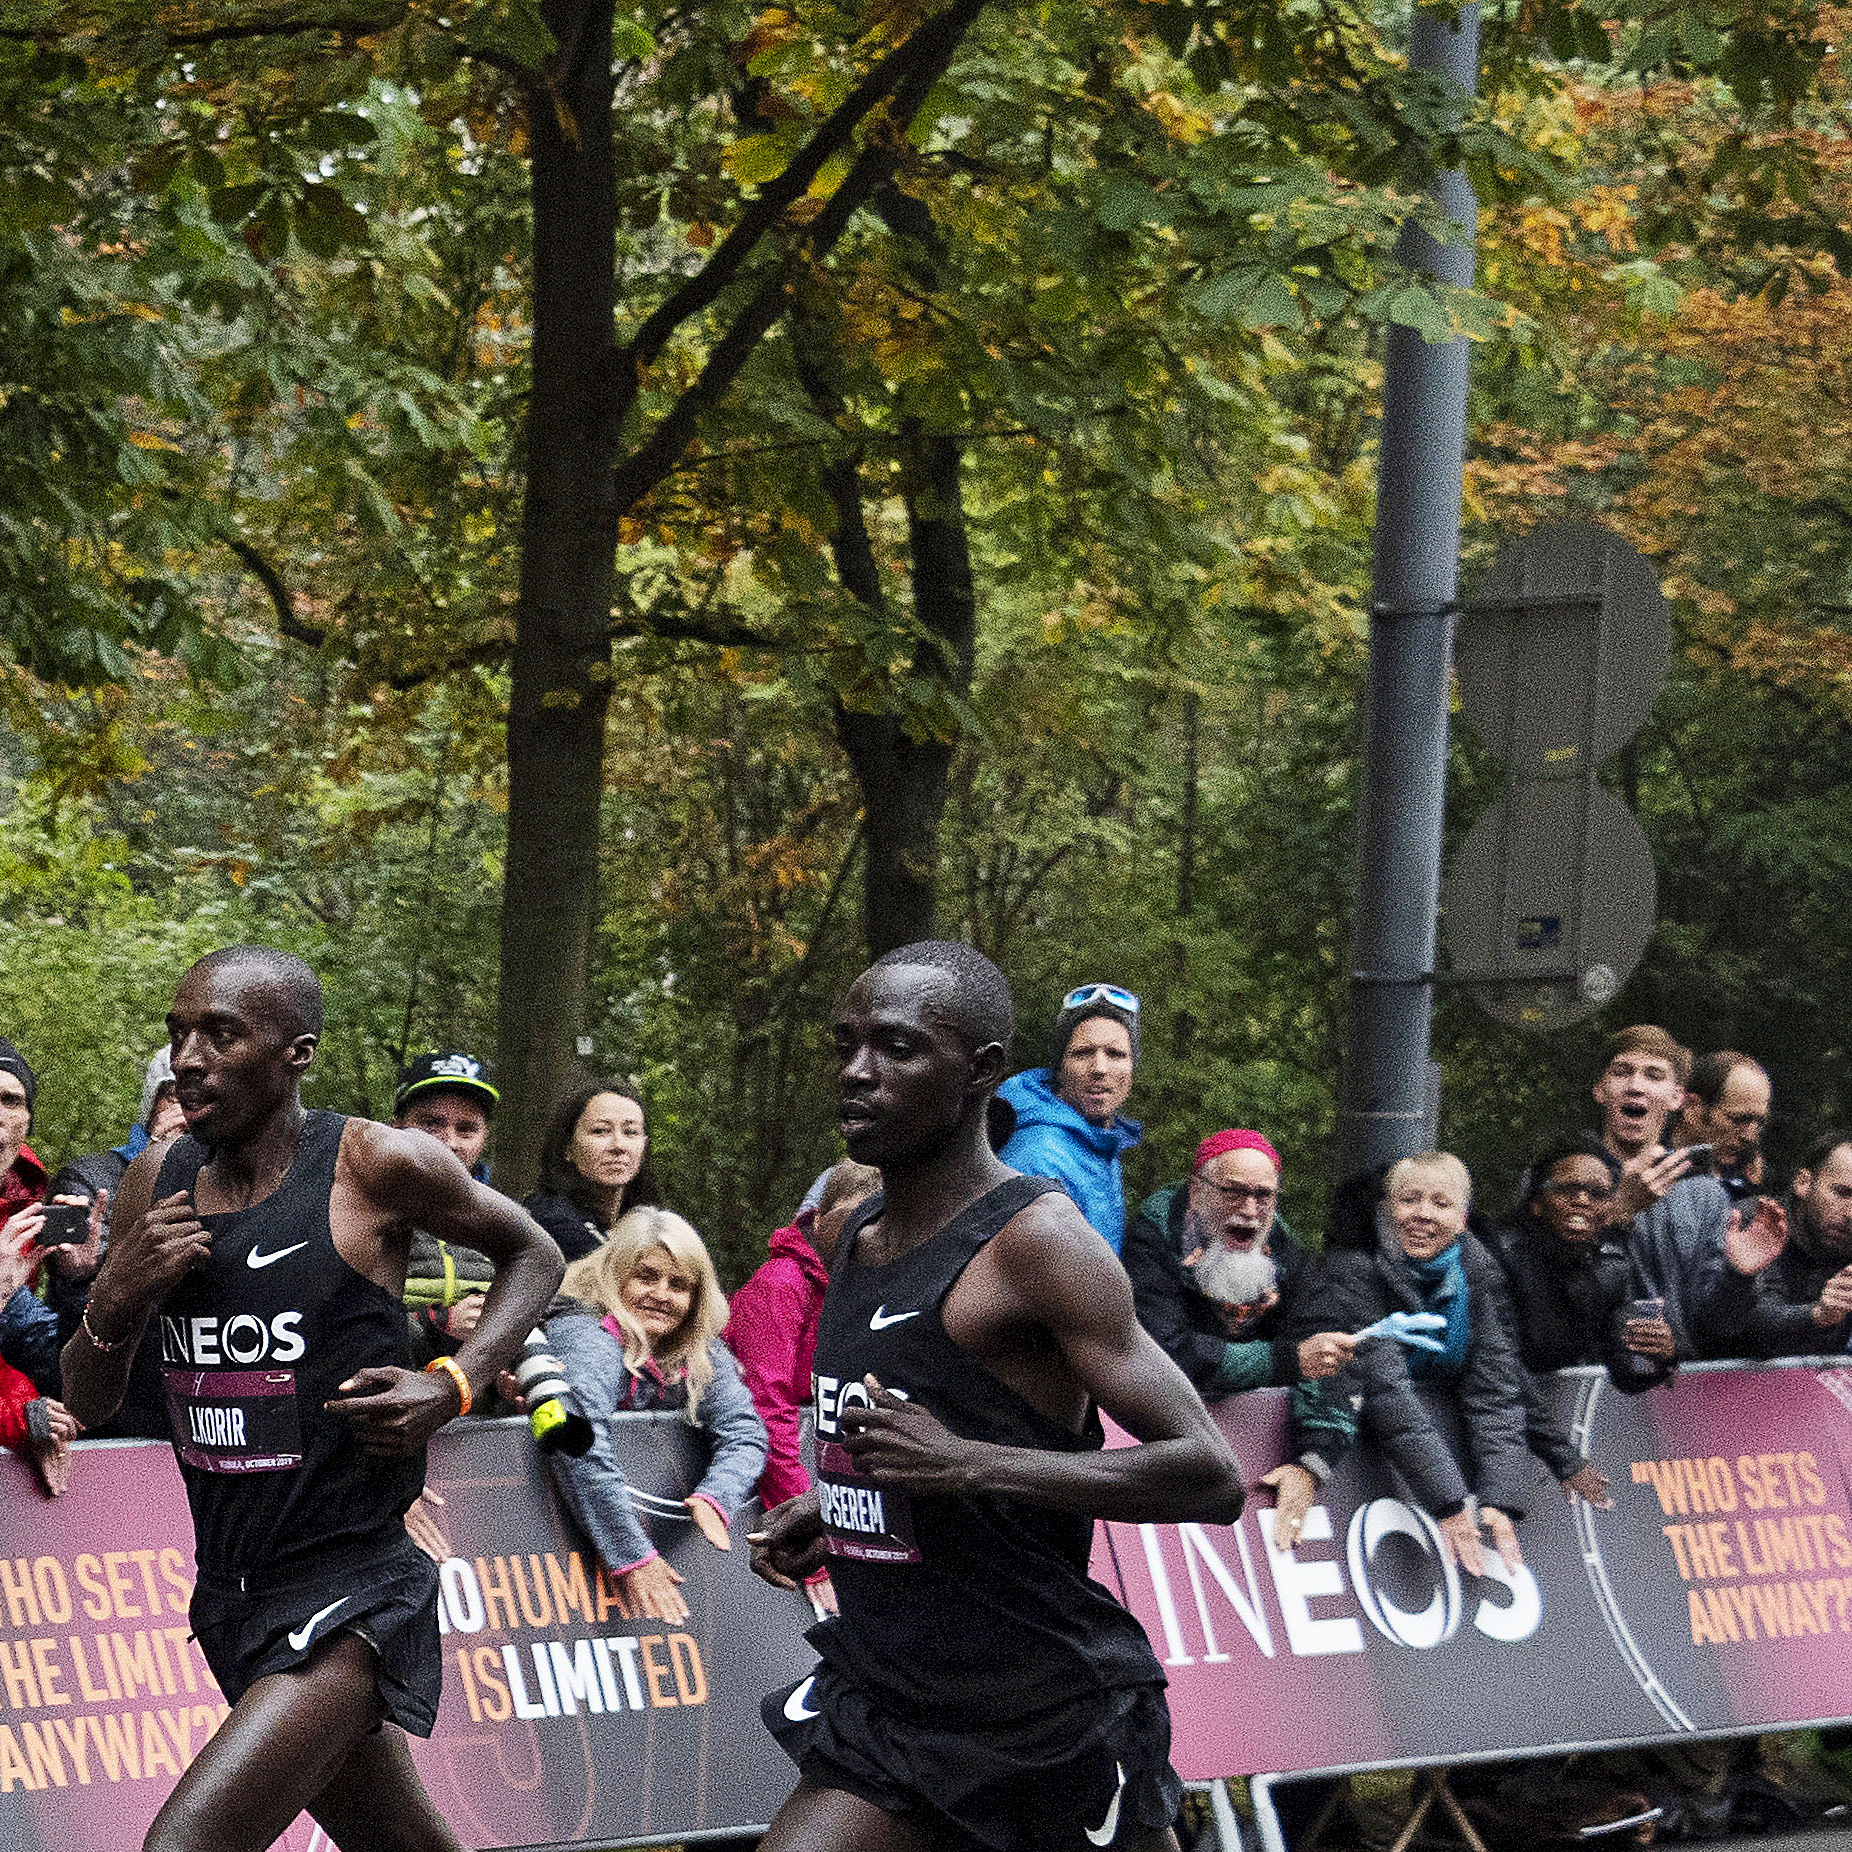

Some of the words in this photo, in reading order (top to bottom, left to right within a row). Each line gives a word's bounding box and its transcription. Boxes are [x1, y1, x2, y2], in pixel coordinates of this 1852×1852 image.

[159, 1311, 306, 1364] INEOS
[1737, 1451, 1826, 1510] SETS
[1662, 1521, 1740, 1581] THE
[1735, 1513, 1852, 1575] LIMITS
[75, 1547, 194, 1622] SETS
[437, 1551, 665, 1635] OHUMA
[457, 1632, 708, 1723] ISLIMITED
